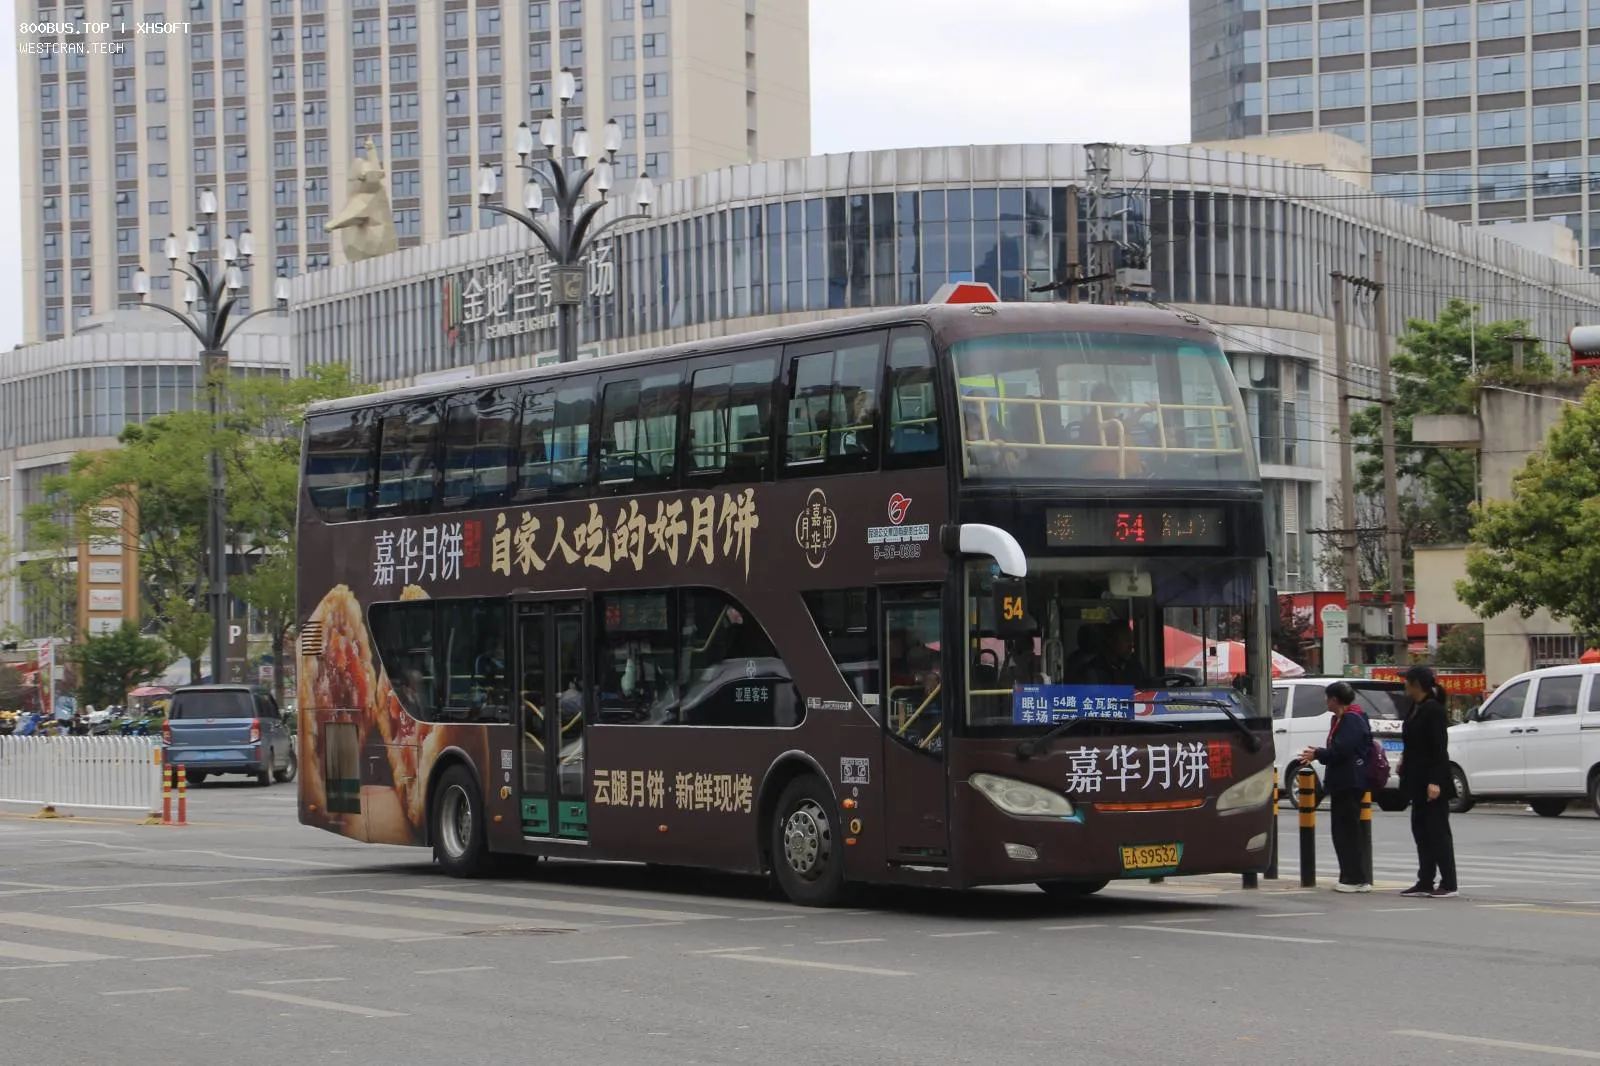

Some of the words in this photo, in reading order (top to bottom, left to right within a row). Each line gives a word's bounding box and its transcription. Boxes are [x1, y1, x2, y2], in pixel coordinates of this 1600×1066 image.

[491, 487, 760, 585] 自家人吃的好月饼
[1114, 512, 1145, 542] 54
[372, 521, 464, 586] 嘉华月饼
[1003, 597, 1023, 620] 54
[228, 624, 242, 644] P
[735, 687, 769, 703] 亚星客车
[1021, 697, 1048, 710] 眠山
[1053, 696, 1077, 708] 54路
[1082, 697, 1129, 710] 金瓦路口
[1022, 710, 1048, 723] 车场
[1065, 742, 1209, 793] 嘉华月饼
[593, 769, 753, 813] 云腿月饼·新鲜现烤
